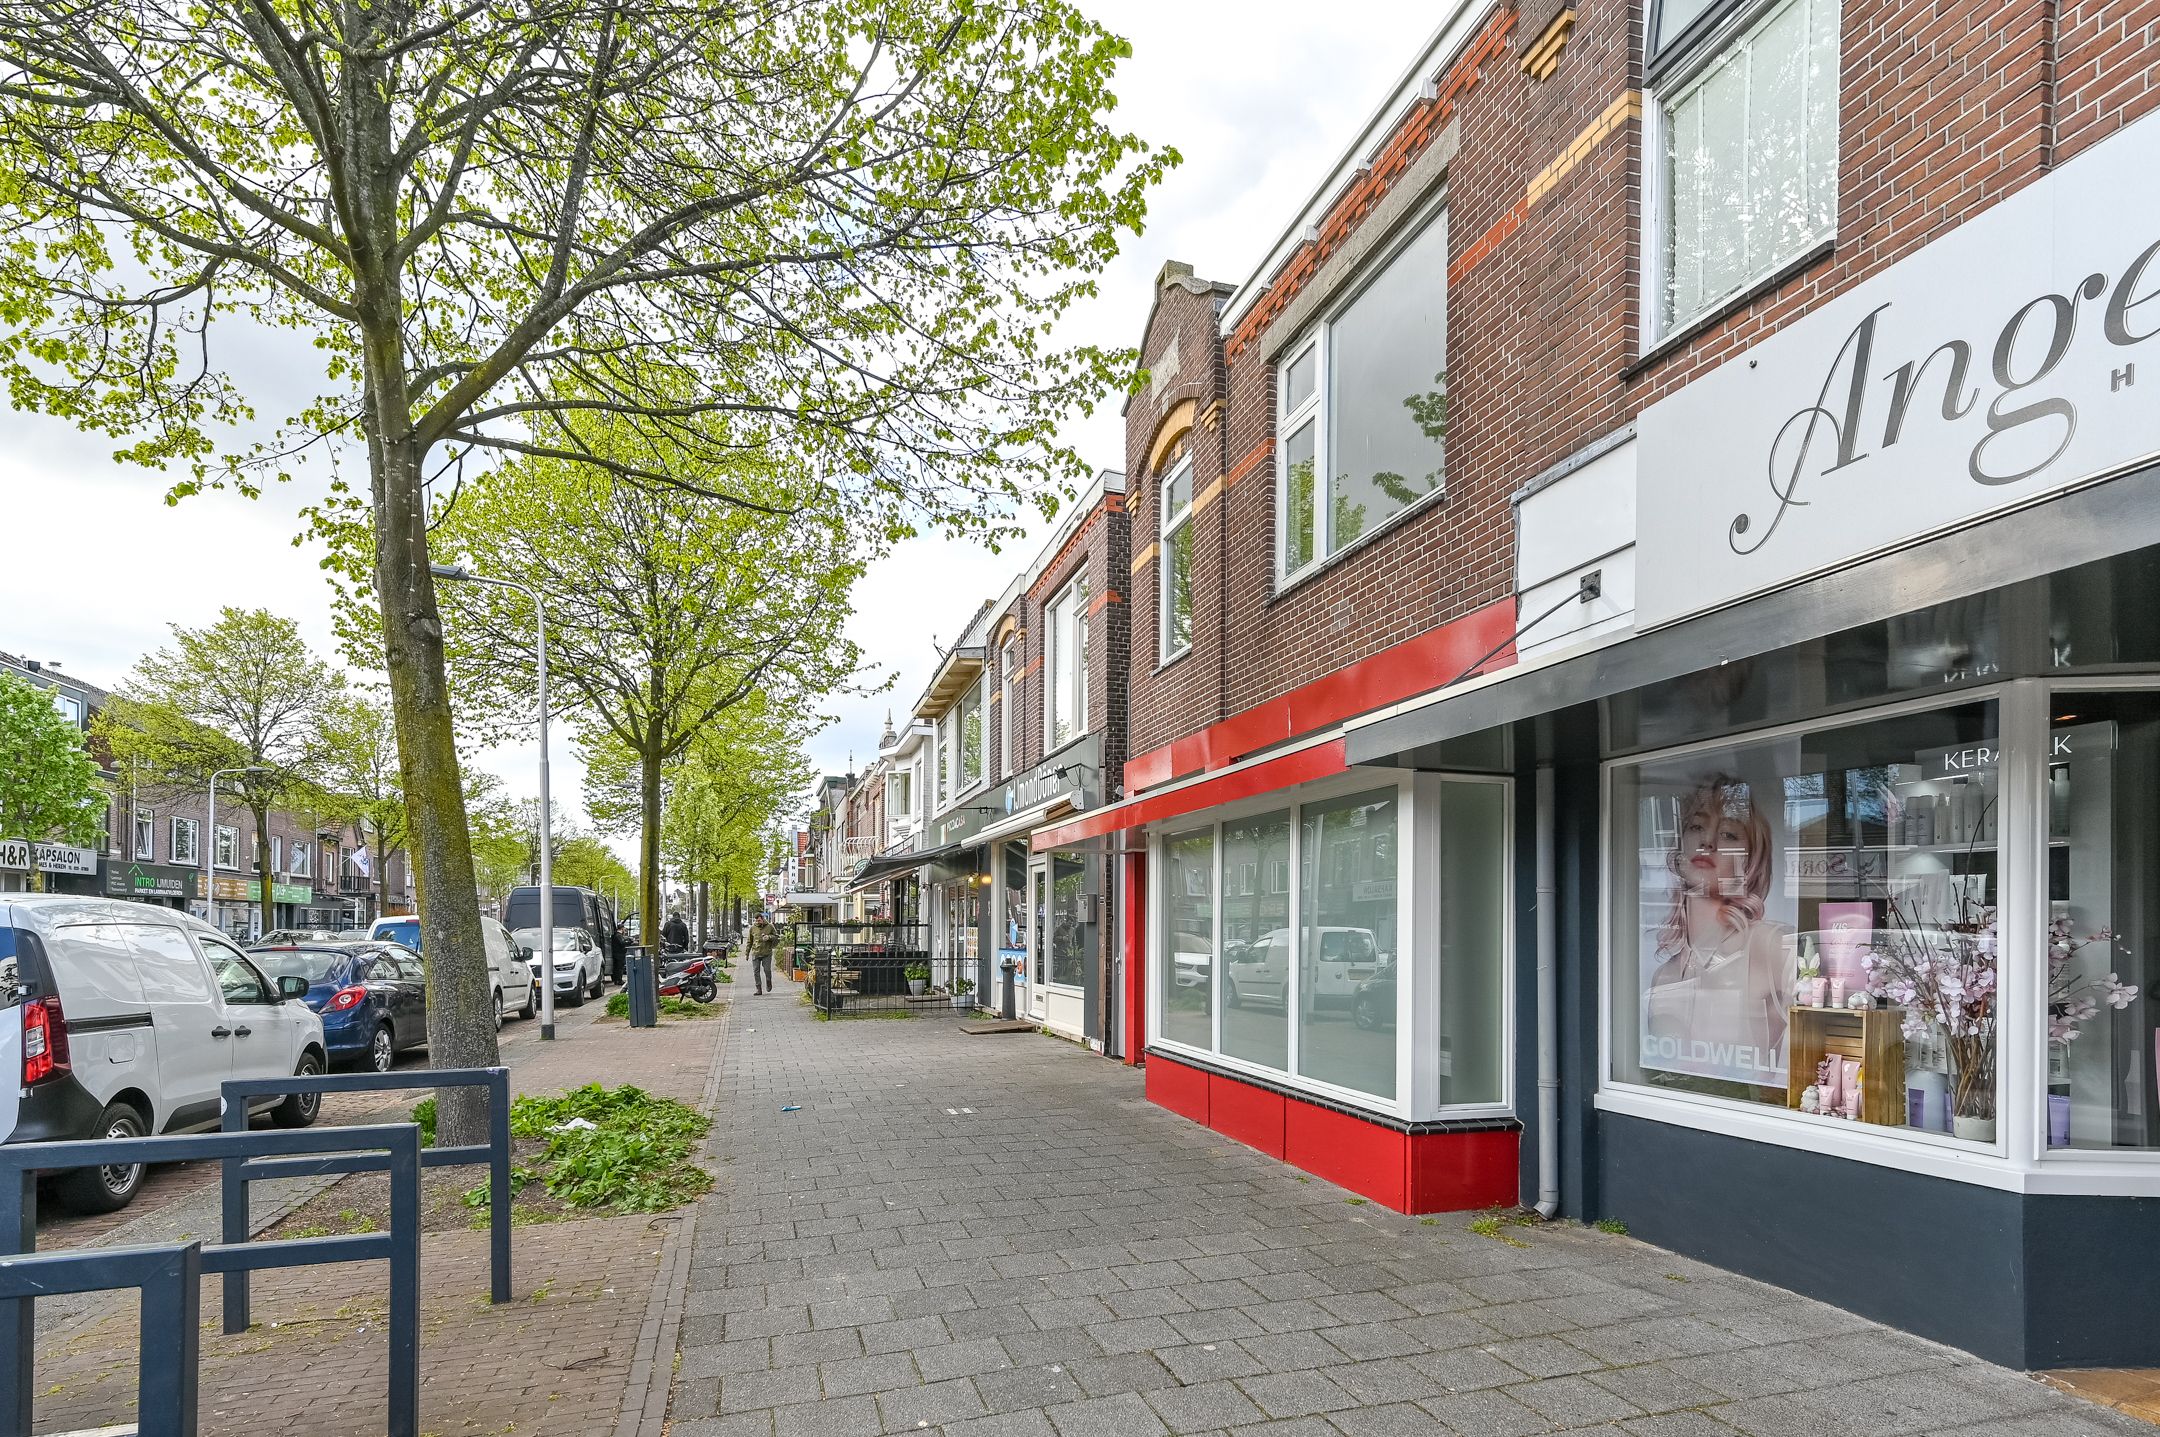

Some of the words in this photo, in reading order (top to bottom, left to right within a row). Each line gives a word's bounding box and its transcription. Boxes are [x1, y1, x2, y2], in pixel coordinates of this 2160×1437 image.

[2111, 363, 2134, 392] H
[134, 876, 155, 888] INTRO
[156, 878, 183, 890] IJMUIDEN
[1643, 1034, 1788, 1074] GOLDWELL
